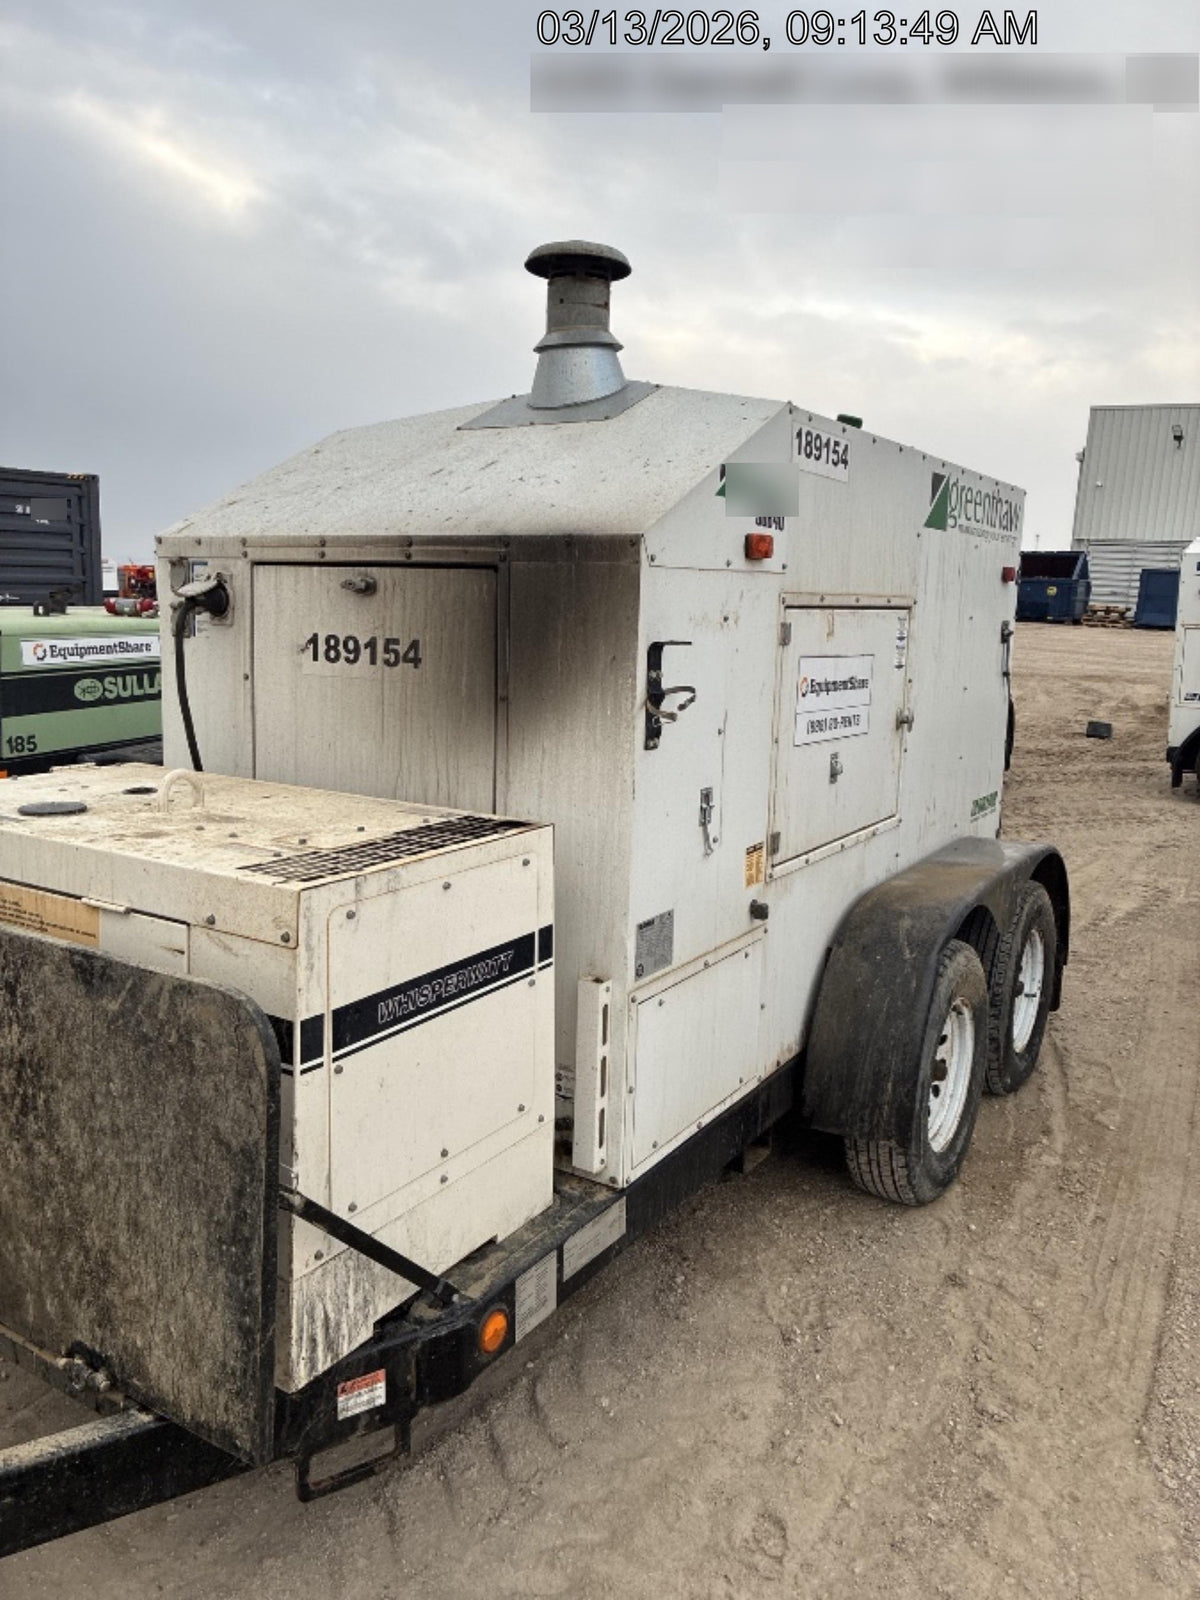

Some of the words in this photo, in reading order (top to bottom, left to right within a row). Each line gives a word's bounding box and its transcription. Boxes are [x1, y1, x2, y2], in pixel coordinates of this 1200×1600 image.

[795, 427, 849, 470] 189154
[49, 640, 152, 660] EquipmentShare
[306, 632, 422, 669] 189154
[6, 734, 38, 754] 185
[377, 950, 515, 1024] WHISPERWATT
